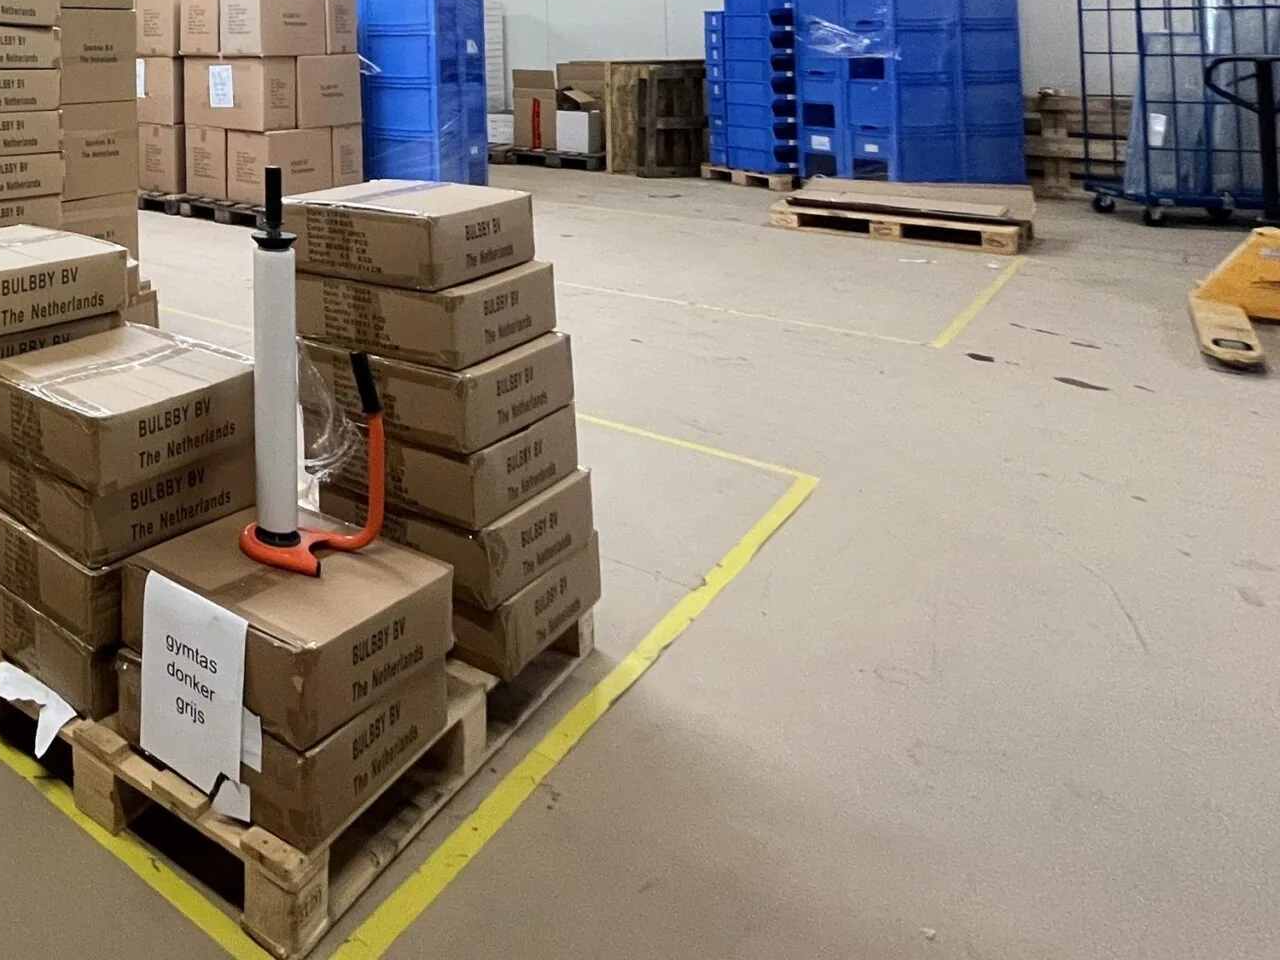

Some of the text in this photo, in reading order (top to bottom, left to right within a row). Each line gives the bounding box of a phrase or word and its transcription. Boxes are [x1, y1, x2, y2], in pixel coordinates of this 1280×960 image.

[465, 221, 491, 241] BULBBY
[1, 266, 79, 296] BULBBY BV
[466, 253, 478, 269] The
[1, 292, 105, 328] The Netherlands
[138, 397, 212, 438] BULBBY BV
[139, 421, 236, 470] The Netherlands
[130, 467, 207, 511] BULBBY BV
[131, 490, 232, 544] The Netherlands
[166, 634, 217, 674] gymtas
[352, 616, 406, 666] BULBBY BV
[166, 661, 215, 701] donker
[352, 644, 424, 702] The Netherlands
[176, 696, 205, 724] grijs
[352, 700, 402, 761] BULBBY BV
[353, 724, 419, 796] The Netherlands
